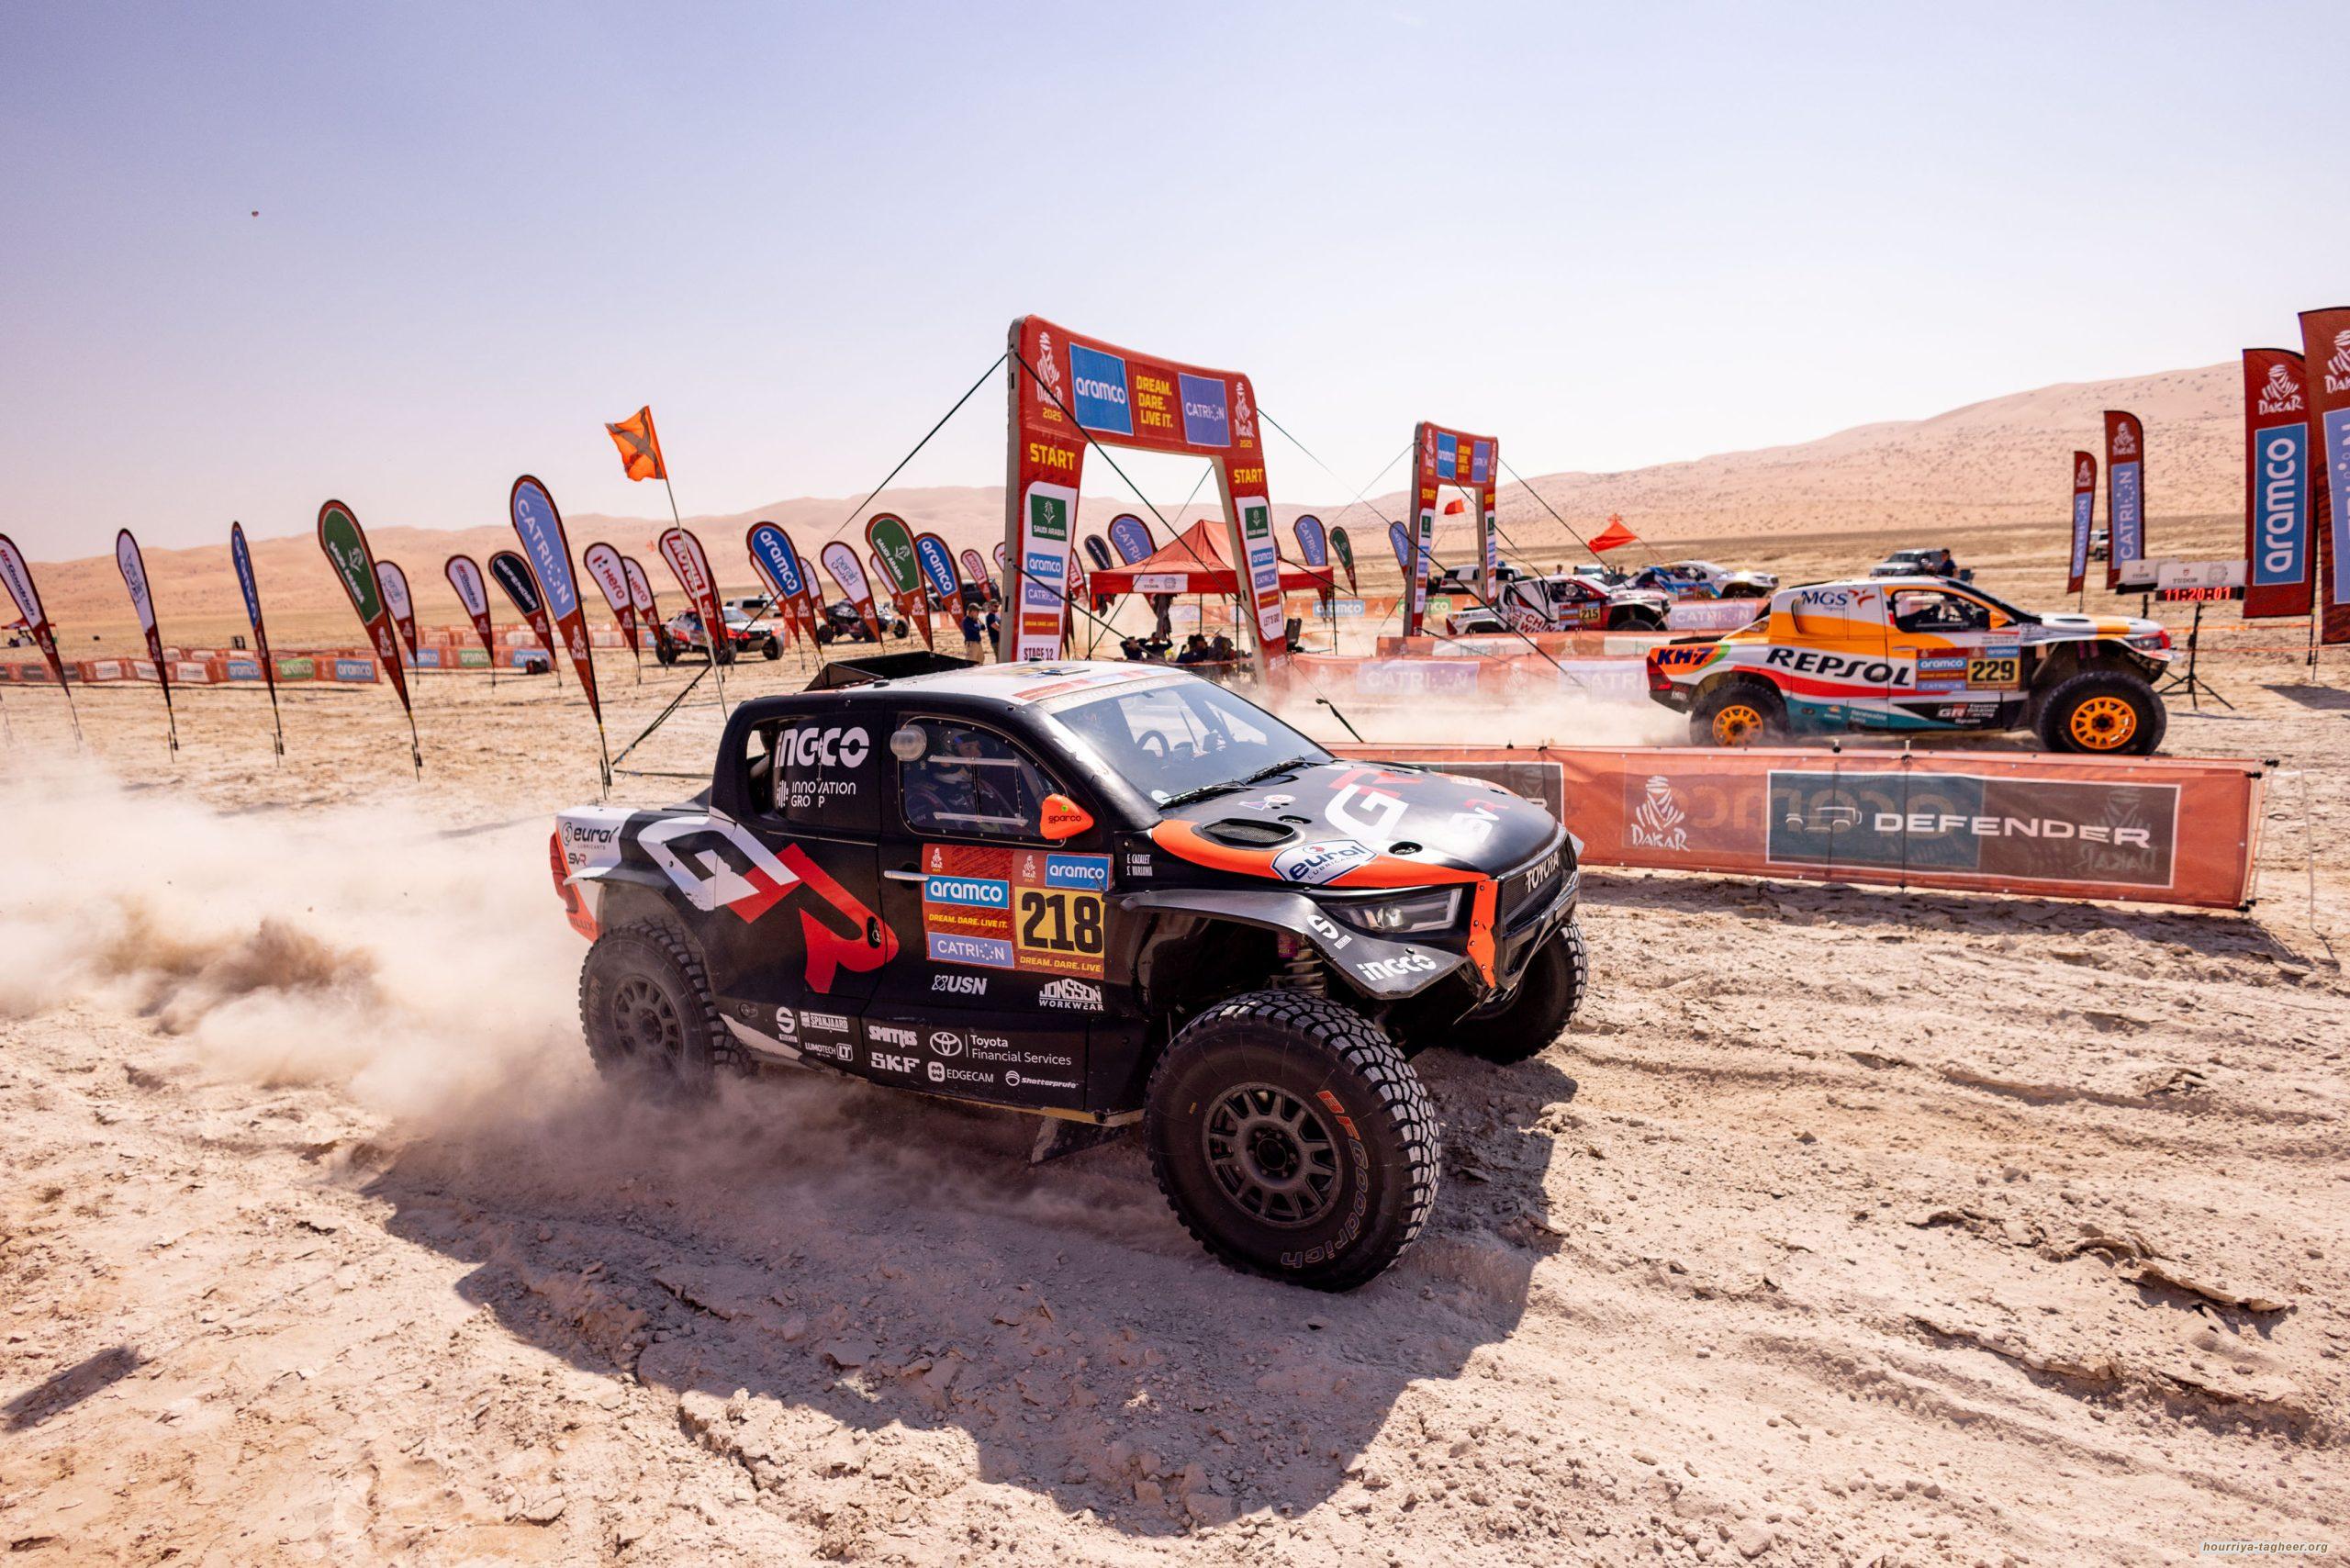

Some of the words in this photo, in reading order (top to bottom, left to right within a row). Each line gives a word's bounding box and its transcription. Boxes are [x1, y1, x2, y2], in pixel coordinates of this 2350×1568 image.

[1075, 376, 1126, 405] aramco
[1136, 375, 1172, 396] DREAM.
[2324, 374, 2350, 395] DAK
[1138, 392, 1166, 410] DARE.
[2258, 394, 2305, 415] DAKAR
[1042, 407, 1062, 422] 2025
[1140, 409, 1160, 427] LIVE
[1162, 413, 1173, 428] IT.
[1185, 402, 1225, 421] CATRION
[1029, 442, 1076, 470] START
[1234, 468, 1263, 484] START
[2120, 470, 2136, 559] CATRION
[2265, 437, 2296, 574] aramco
[518, 498, 570, 604] CATRION
[1115, 524, 1143, 562] CATRI
[759, 531, 798, 592] aramco
[876, 538, 890, 558] SAUDI
[888, 556, 904, 582] ARABIA
[922, 541, 953, 592] aramco
[1029, 558, 1061, 573] aramco
[1252, 552, 1273, 563] aramco
[1028, 588, 1060, 602] CATRION
[1801, 590, 1848, 606] MGS
[2165, 587, 2232, 602] 11:20:01
[1316, 604, 1361, 613] aamco
[1581, 610, 1599, 620] 215
[1675, 610, 1749, 622] CATRION
[1024, 647, 1044, 660] STAGE
[1046, 648, 1054, 660] 12
[1765, 648, 1910, 686] REPSOL
[1920, 659, 1964, 668] aramco
[1972, 660, 2016, 682] 229
[1572, 671, 1649, 692] CATRI
[791, 796, 825, 808] GROP
[1048, 814, 1081, 823] sparco
[1631, 824, 1690, 852] DAKAR
[1874, 813, 2152, 848] DEFENDER
[1049, 864, 1104, 880] aramco
[1525, 852, 1560, 893] TOYOTA
[930, 880, 1003, 902] aramco
[928, 913, 957, 924] DREAM.
[957, 916, 979, 925] DARE.
[980, 919, 998, 927] LIVE
[1022, 891, 1102, 954] 218
[937, 940, 1005, 961] CATRION
[1020, 957, 1052, 967] DREAM.
[1054, 959, 1080, 969] DARE.
[1081, 963, 1102, 972] LIVE
[947, 975, 988, 995] USN
[1039, 979, 1102, 1002] JONSSON
[1039, 999, 1103, 1011] WORKWEAR
[811, 1015, 848, 1029] SPANJAARD
[805, 1042, 837, 1056] LUMOTECH
[970, 1035, 1008, 1051] Toyota
[870, 1052, 920, 1073] SKF
[971, 1048, 1022, 1063] Financial
[1024, 1051, 1071, 1066] Services
[946, 1068, 994, 1084] EDGECAM
